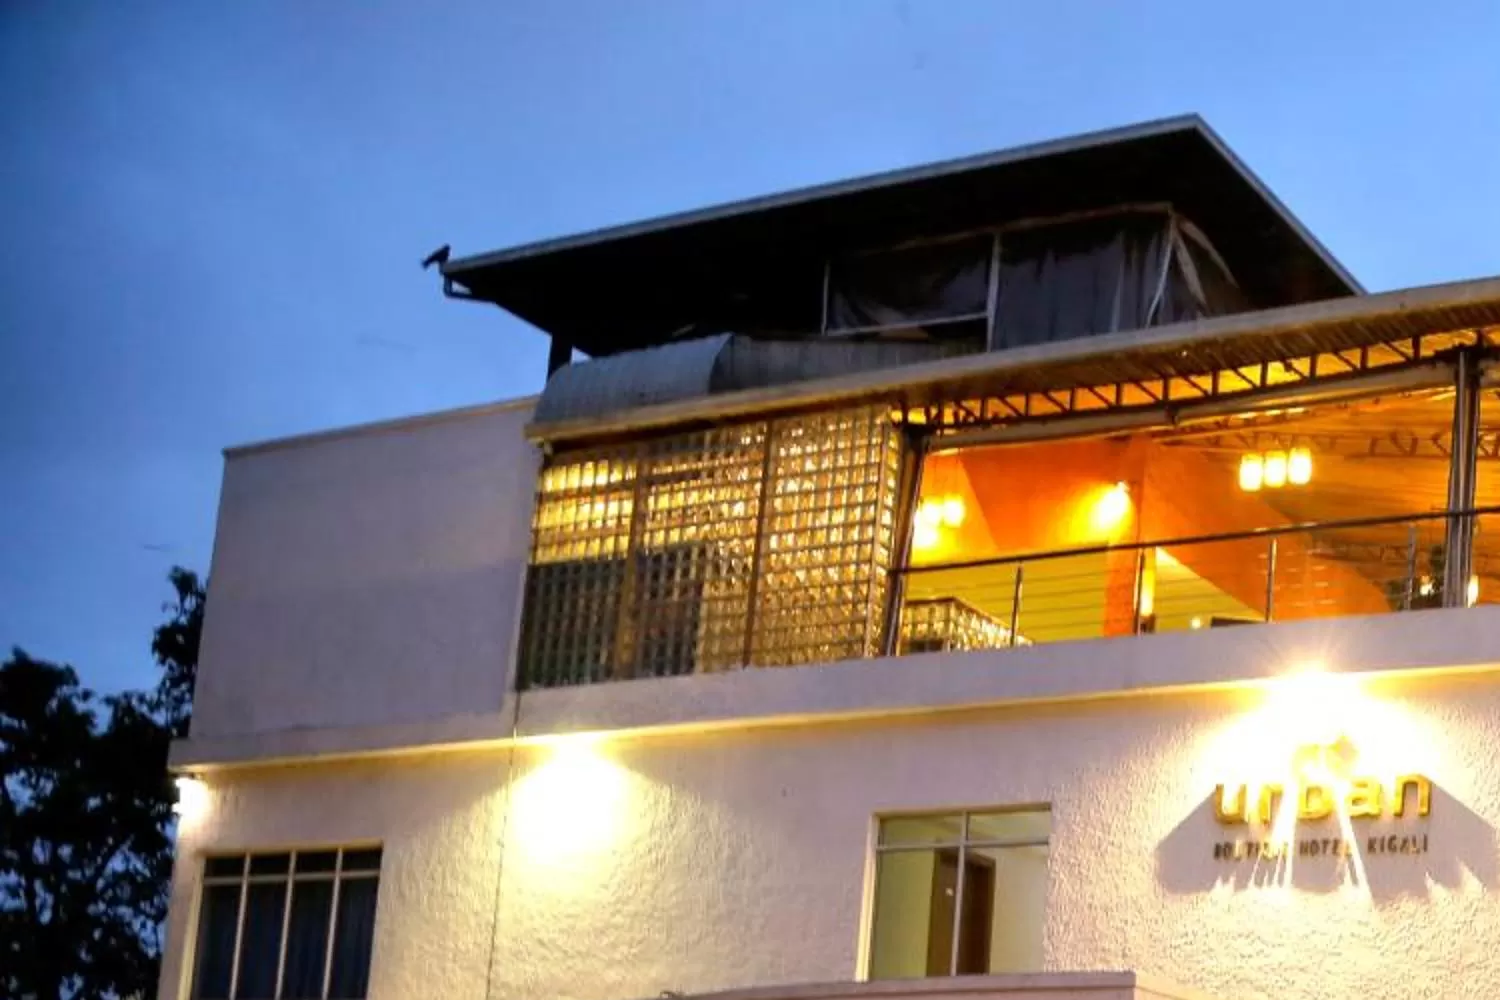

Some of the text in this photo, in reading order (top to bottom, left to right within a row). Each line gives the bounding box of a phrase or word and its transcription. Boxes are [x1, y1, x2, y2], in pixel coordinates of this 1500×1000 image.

[1214, 752, 1432, 824] urban
[1213, 840, 1290, 862] BOUTI
[1367, 834, 1429, 855] KIGALI
